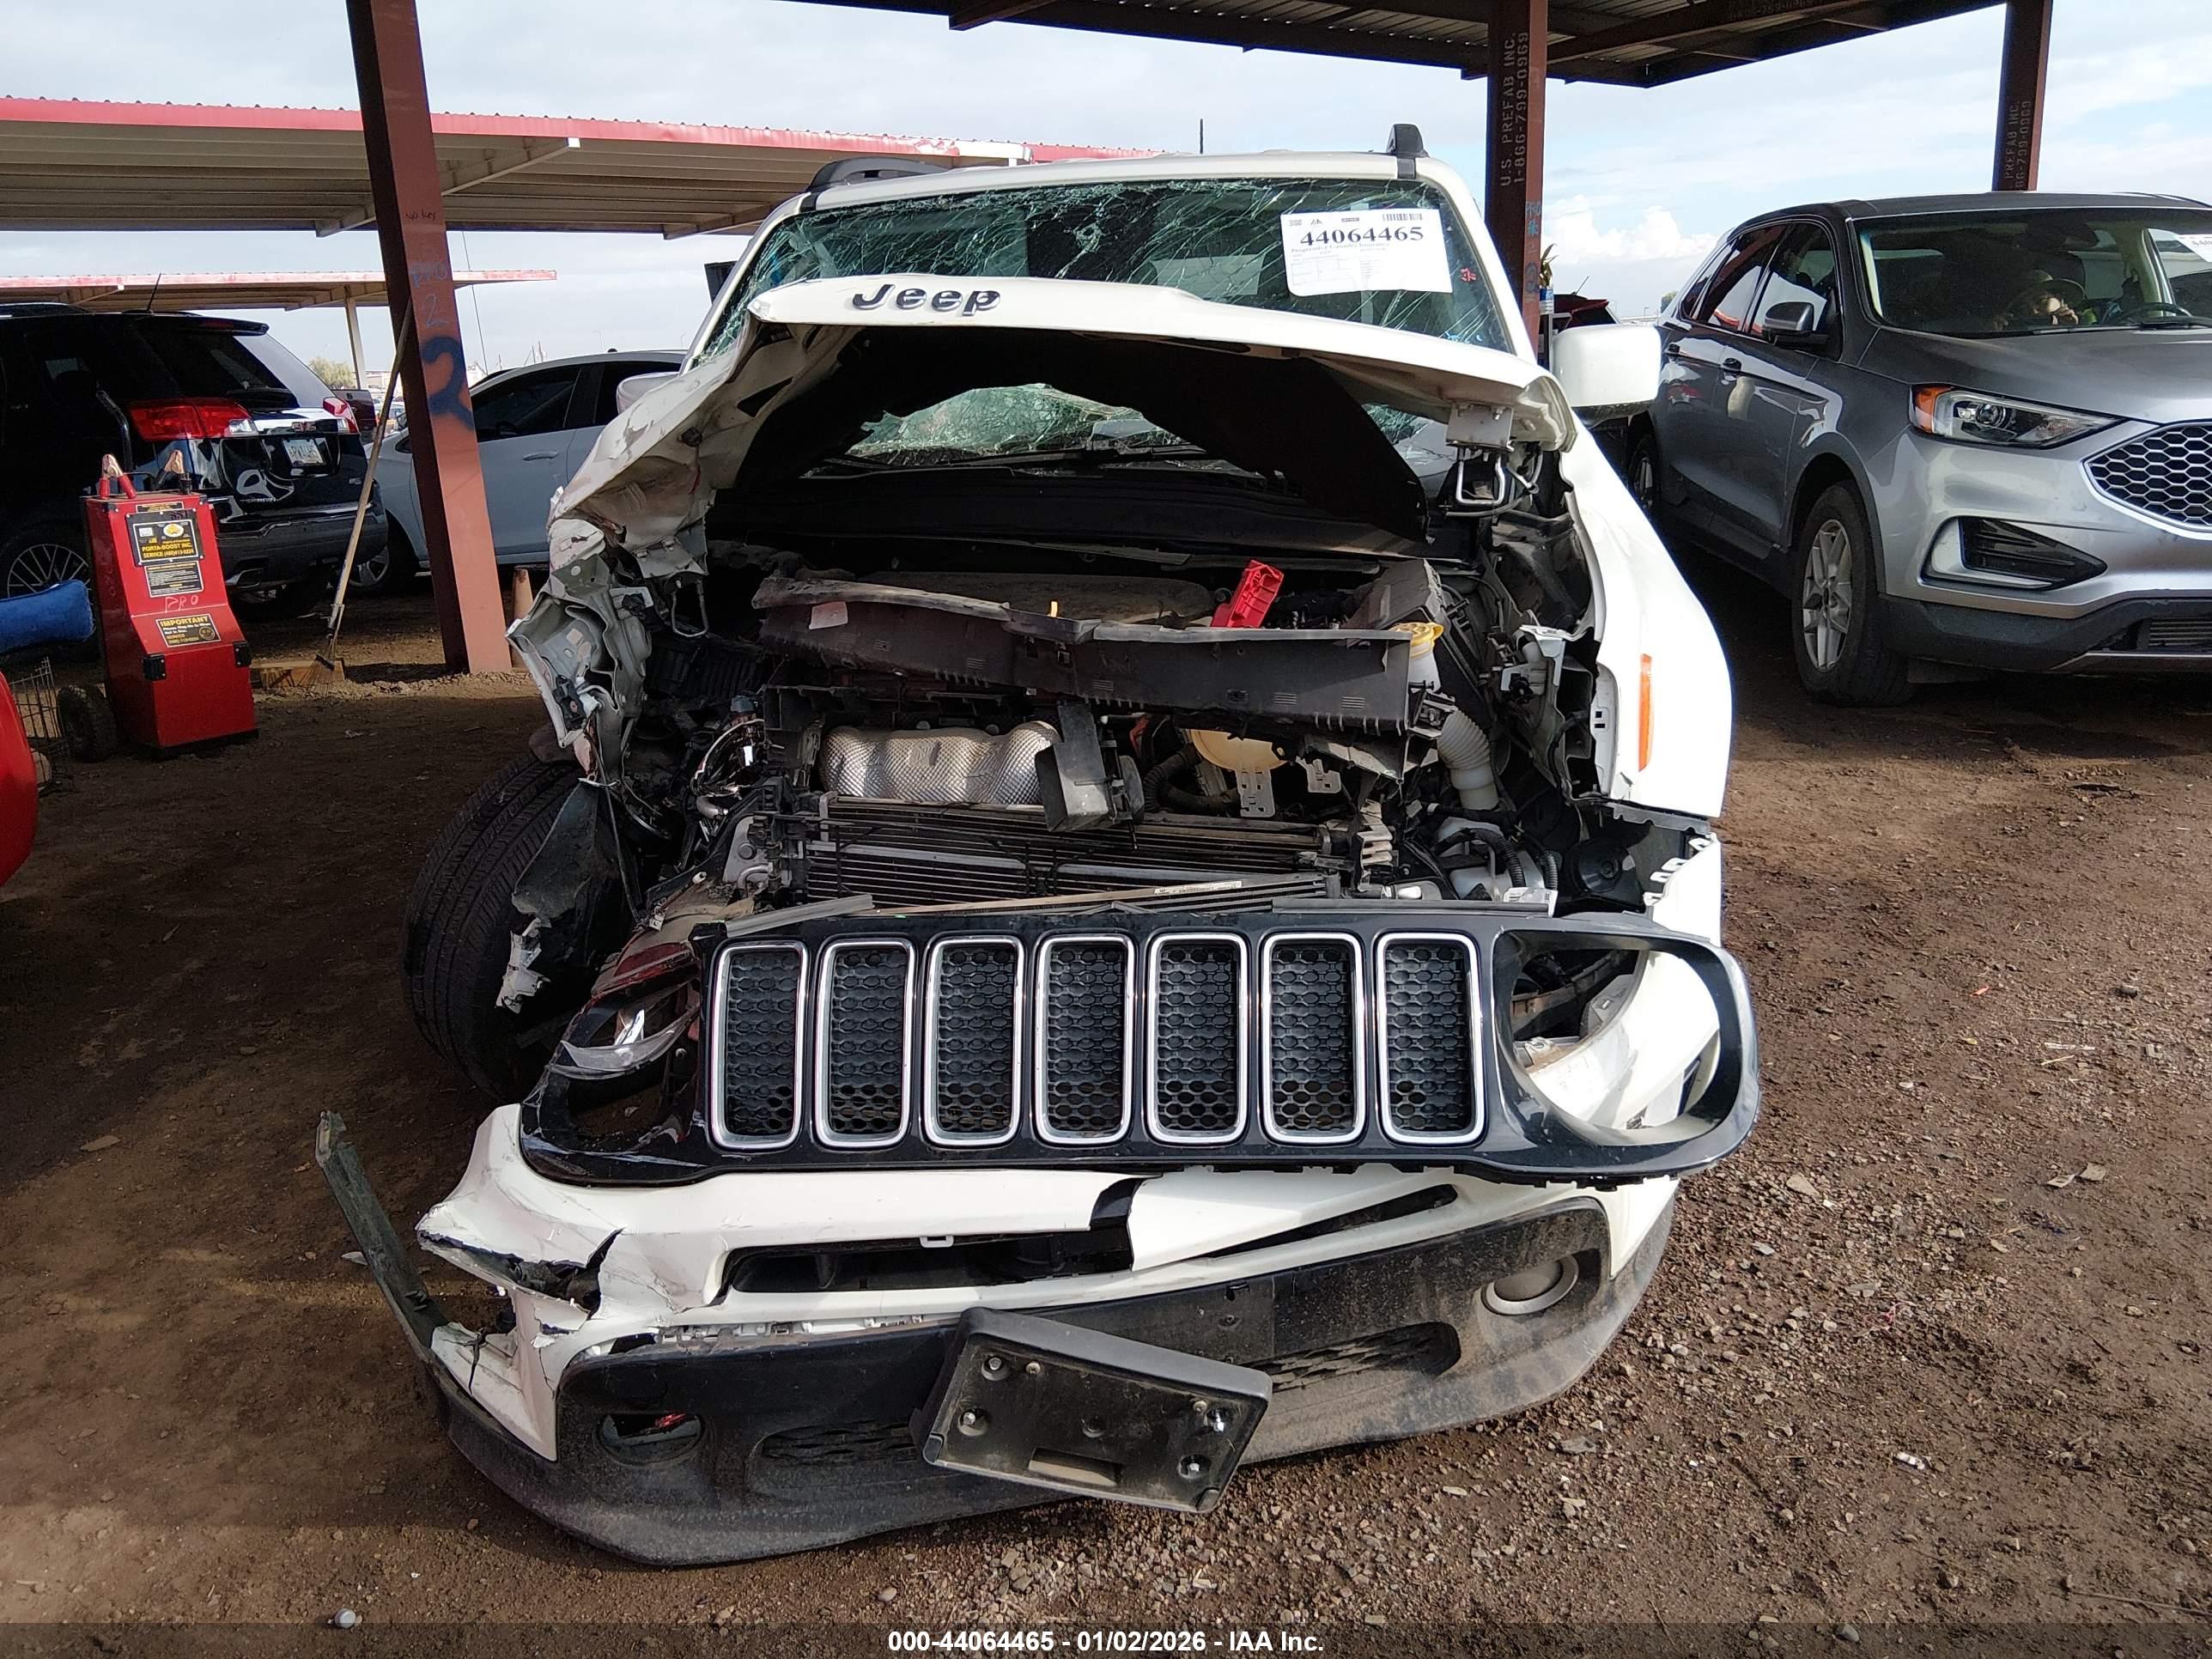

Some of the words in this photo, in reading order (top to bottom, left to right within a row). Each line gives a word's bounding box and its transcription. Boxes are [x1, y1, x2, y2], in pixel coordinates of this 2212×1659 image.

[1504, 33, 1516, 66] INC.
[1502, 76, 1515, 143] PREFAB
[1514, 32, 1528, 183] 1-866-799-0969
[1500, 154, 1513, 186] U.S.
[2005, 131, 2017, 179] PREFAB
[1300, 227, 1424, 246] 44064465
[852, 283, 1001, 317] Jeep
[165, 594, 198, 612] PRO
[160, 617, 209, 627] IMPORTANT
